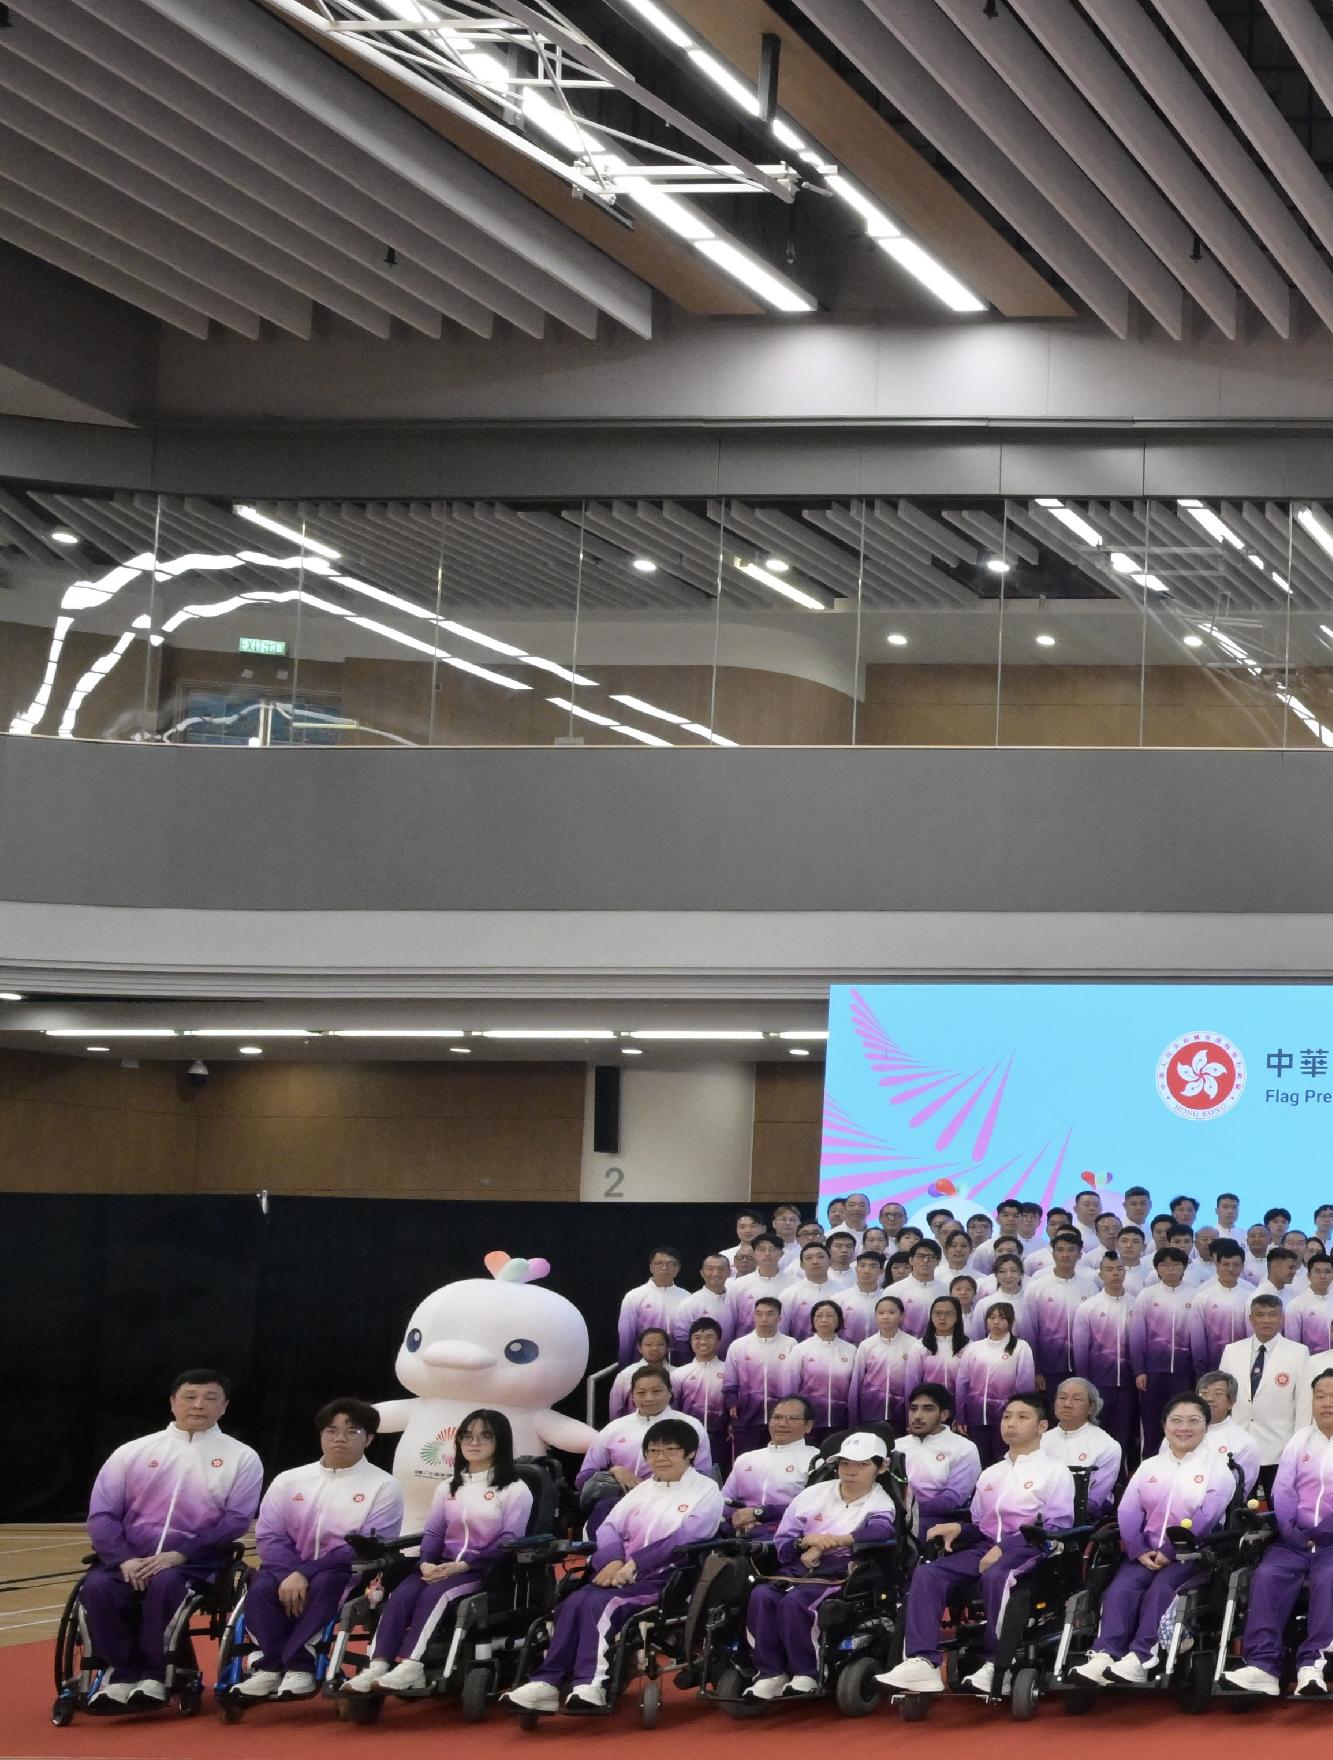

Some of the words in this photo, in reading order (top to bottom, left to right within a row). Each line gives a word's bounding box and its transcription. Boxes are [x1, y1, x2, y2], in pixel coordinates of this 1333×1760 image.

[241, 639, 263, 652] EXIT
[1265, 1088, 1300, 1107] Flag
[1174, 1103, 1199, 1118] HONG
[604, 1166, 625, 1198] 2
